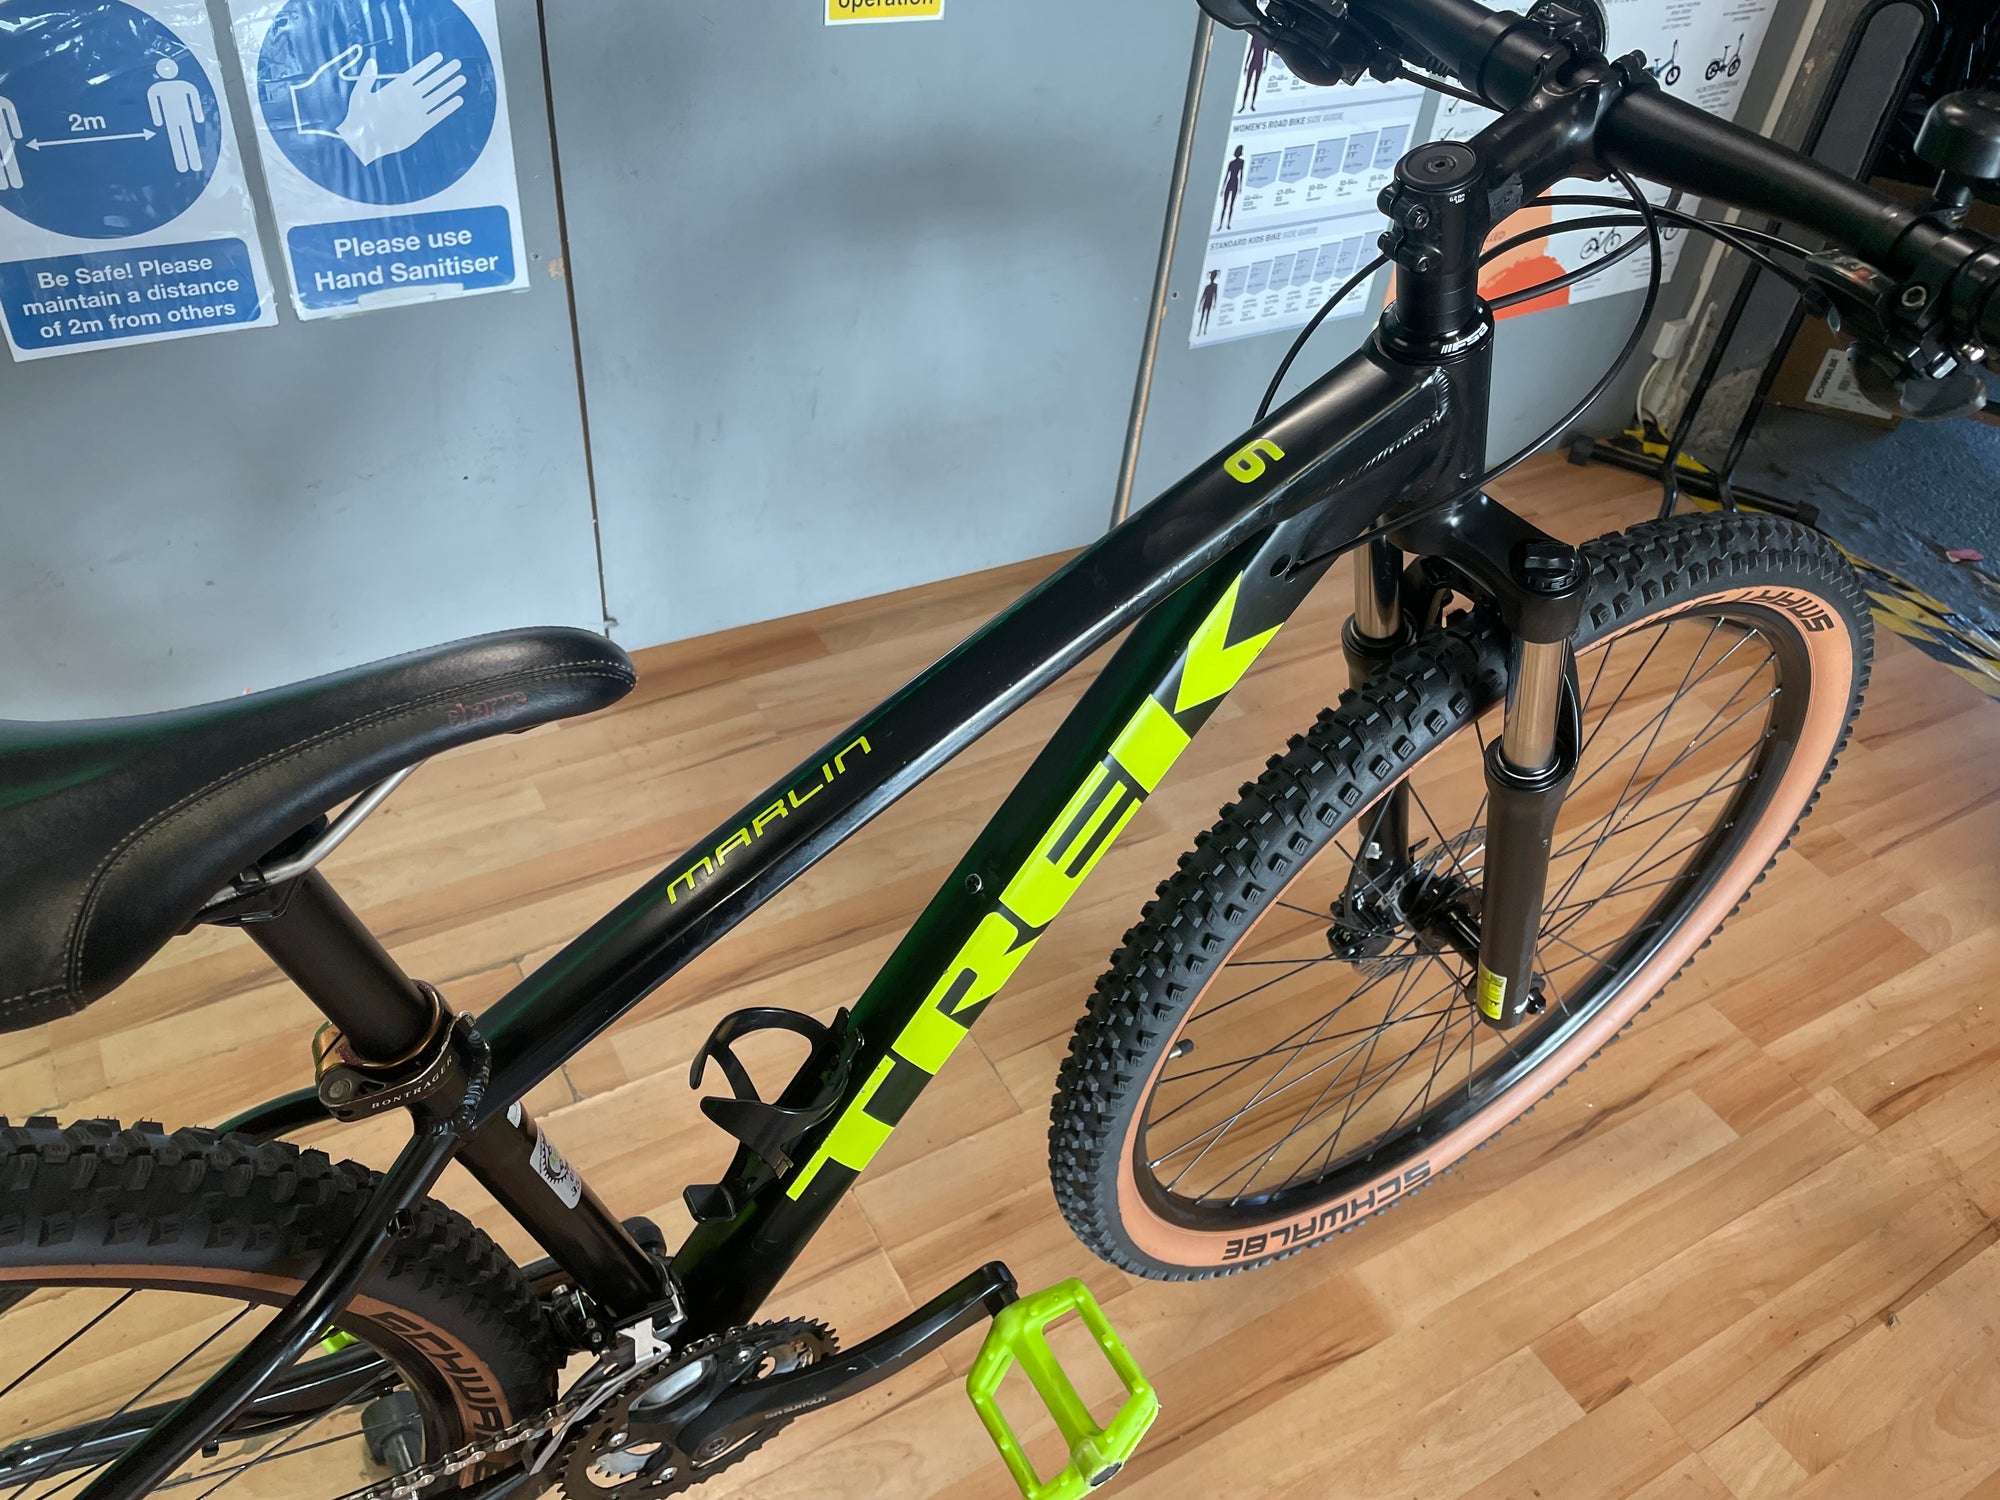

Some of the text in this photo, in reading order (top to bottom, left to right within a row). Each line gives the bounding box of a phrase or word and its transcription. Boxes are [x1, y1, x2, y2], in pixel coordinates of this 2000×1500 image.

[69, 114, 106, 131] 2m
[1233, 121, 1267, 133] WOMEN'S
[1268, 119, 1288, 128] ROAD
[1289, 117, 1306, 126] BIKE
[334, 228, 472, 259] Please use
[1210, 236, 1248, 250] STANDARD
[1249, 234, 1265, 244] KIDS
[1265, 232, 1282, 242] BIKE
[37, 254, 213, 289] Be Safe! Please
[315, 253, 498, 292] Hand Sanitiser
[23, 277, 239, 315] maintain a distance
[40, 301, 236, 339] of 2m from others
[1224, 438, 1285, 483] 6
[667, 736, 871, 904] MARLIN
[786, 571, 1284, 1201] TREK
[371, 1055, 453, 1109] BONTRAGER
[1222, 1160, 1431, 1260] SCHWALBE
